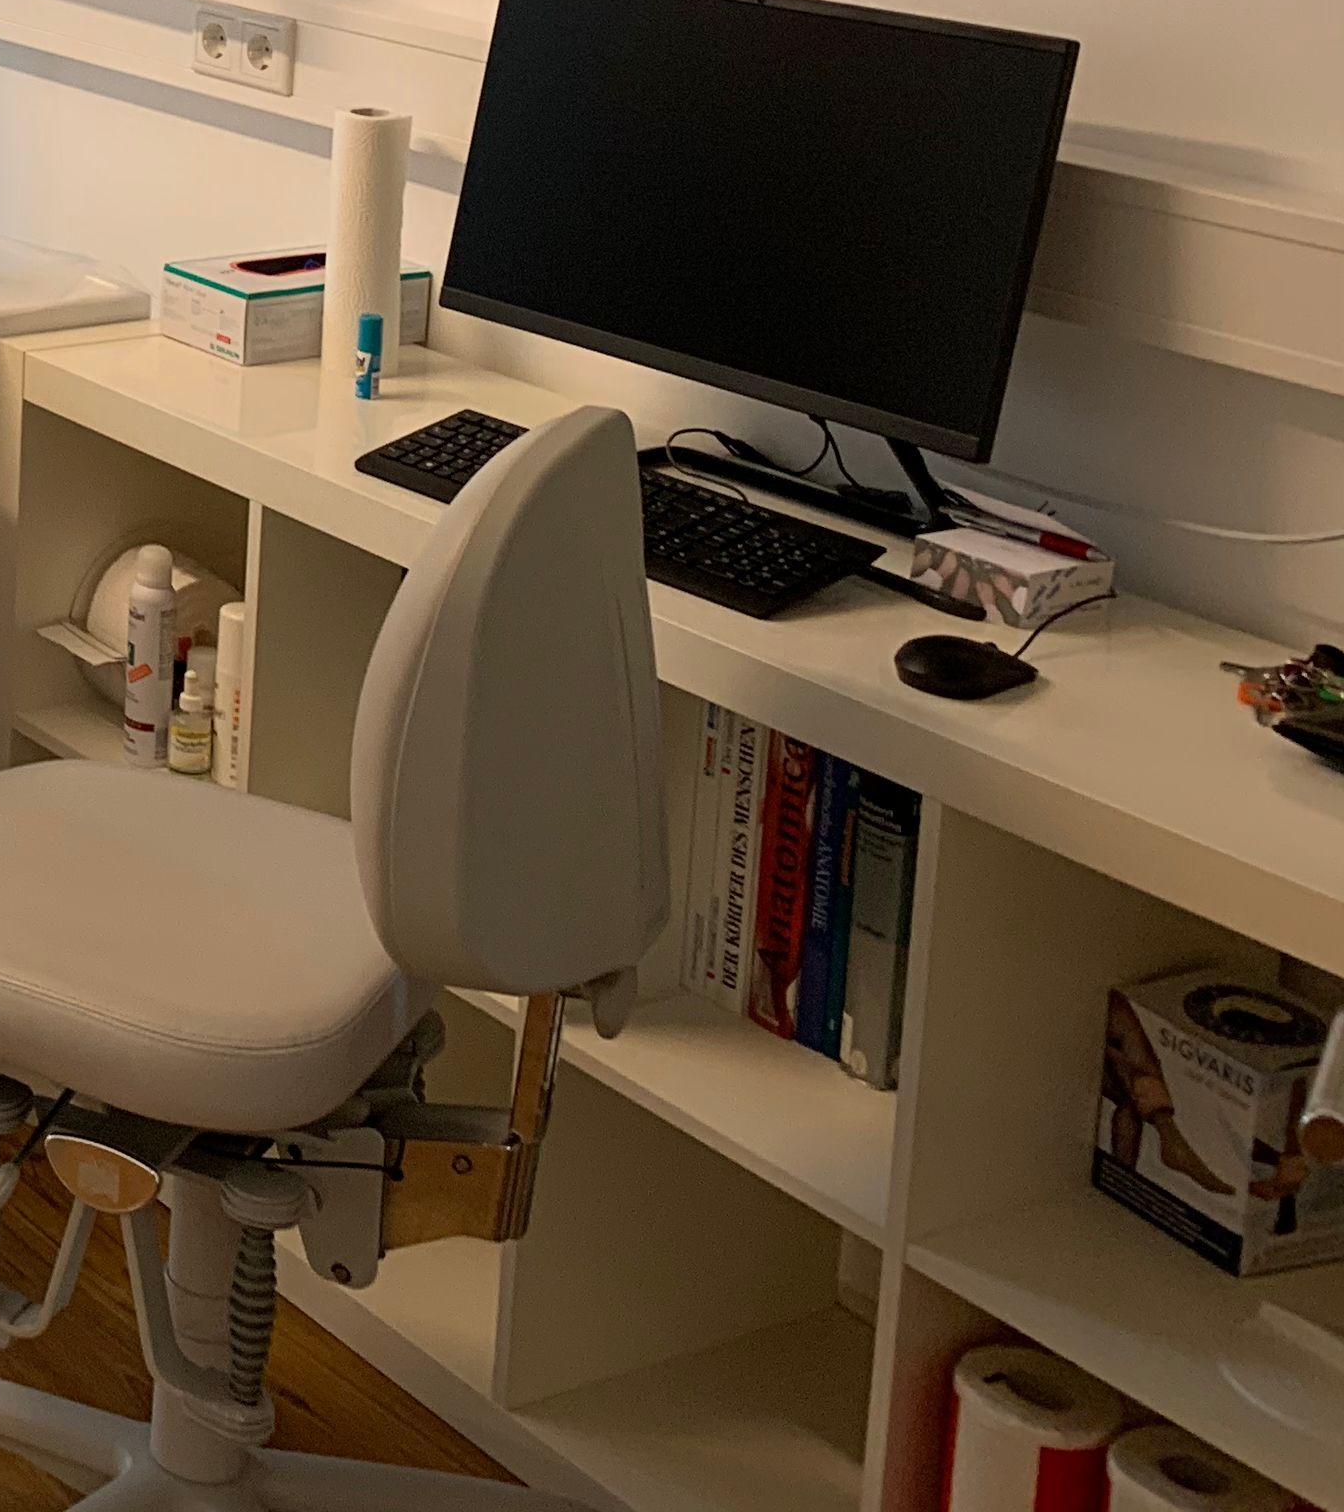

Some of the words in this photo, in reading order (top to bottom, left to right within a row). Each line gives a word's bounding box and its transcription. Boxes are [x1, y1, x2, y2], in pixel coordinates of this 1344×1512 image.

[733, 725, 757, 828] MENSCHEN
[731, 831, 750, 868] DES
[725, 870, 745, 950] KÖRPER
[812, 843, 834, 933] ANATOMIE
[721, 951, 740, 991] DER
[1159, 1027, 1255, 1096] SIGVARIS
